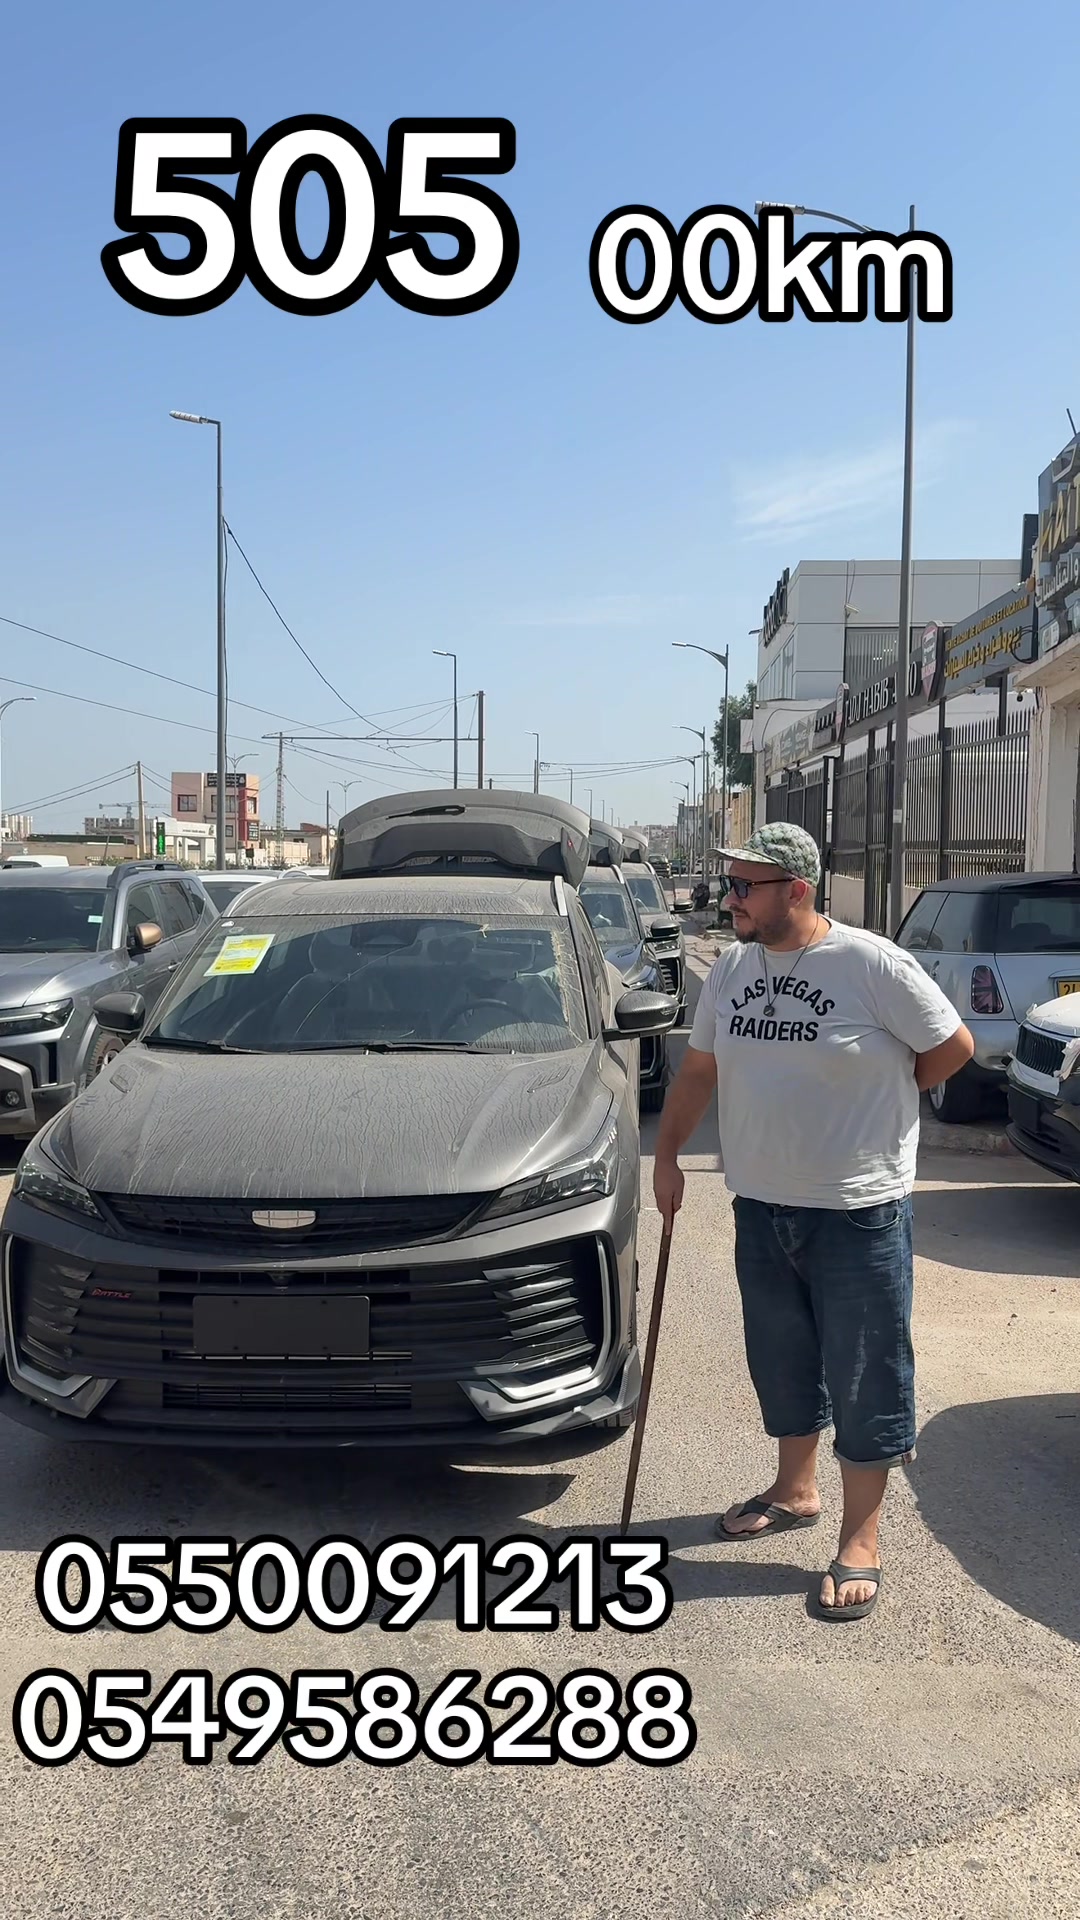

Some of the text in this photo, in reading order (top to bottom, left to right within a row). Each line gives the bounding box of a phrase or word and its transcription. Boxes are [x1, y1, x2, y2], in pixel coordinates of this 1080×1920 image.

[862, 677, 889, 719] HABIB
[892, 661, 918, 704] AO
[731, 976, 836, 1017] LAS VEGAS
[729, 1015, 819, 1042] RAIDERS
